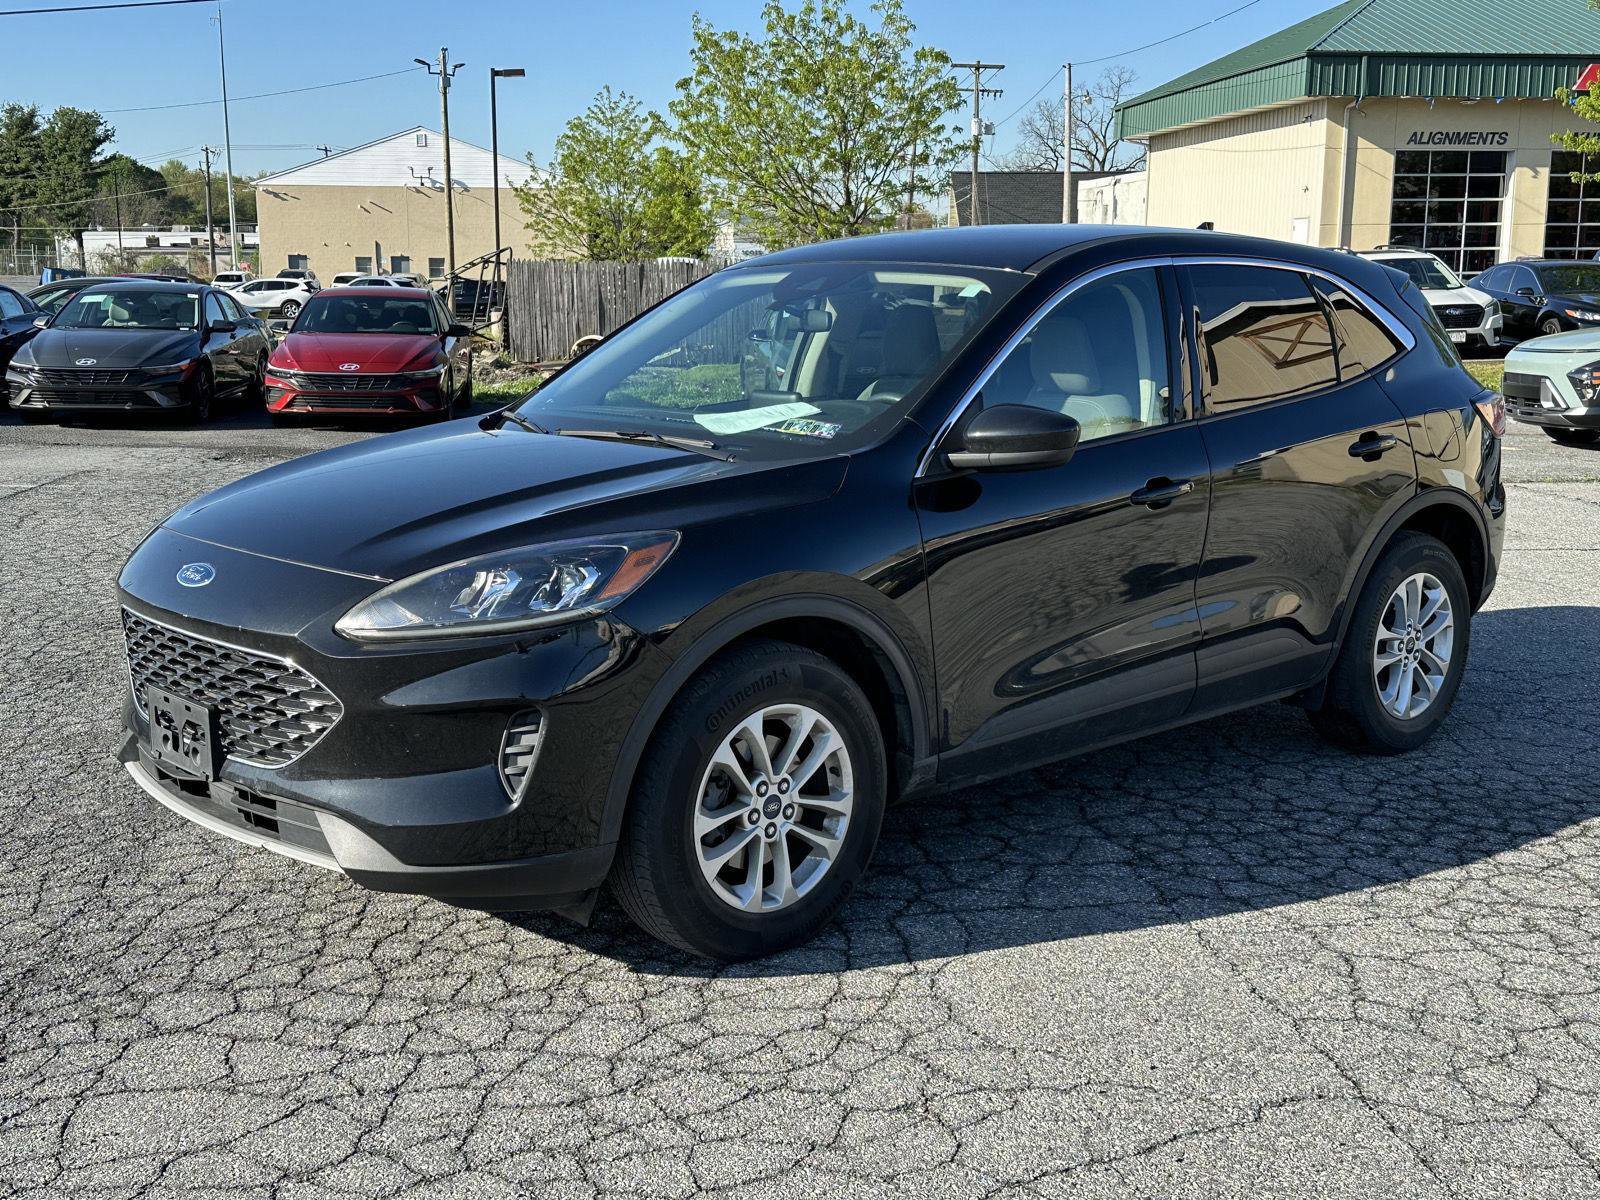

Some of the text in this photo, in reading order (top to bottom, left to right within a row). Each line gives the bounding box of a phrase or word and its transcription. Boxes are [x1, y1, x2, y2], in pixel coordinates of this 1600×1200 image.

[1407, 131, 1508, 146] ALIGNMENTS
[180, 564, 208, 583] Ford
[704, 668, 778, 734] Continental
